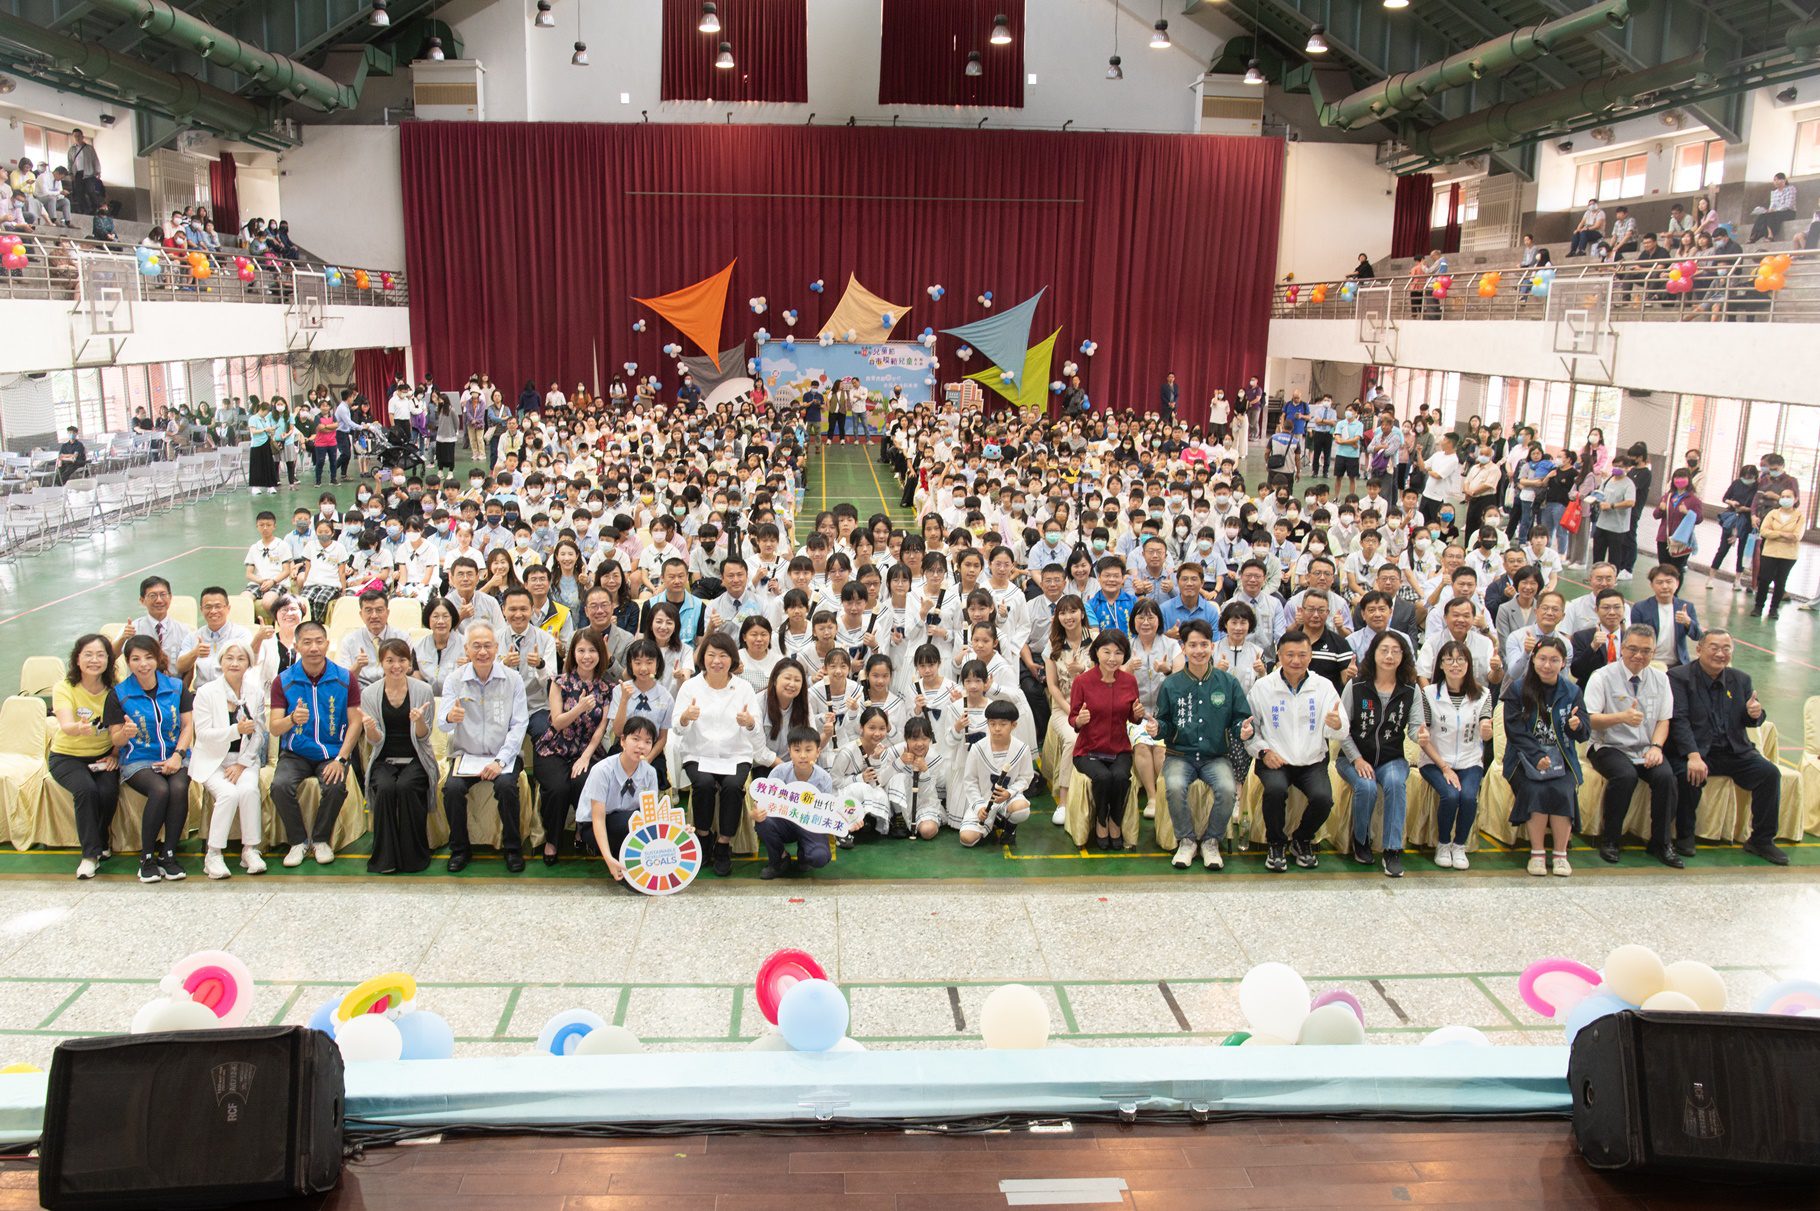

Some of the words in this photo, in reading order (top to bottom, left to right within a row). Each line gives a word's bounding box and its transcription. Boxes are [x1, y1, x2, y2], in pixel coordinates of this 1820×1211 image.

[756, 782, 834, 812] 教育典範新世代
[768, 802, 844, 832] 幸福永續創未來
[646, 856, 677, 867] GOALS
[227, 1103, 238, 1121] RCF
